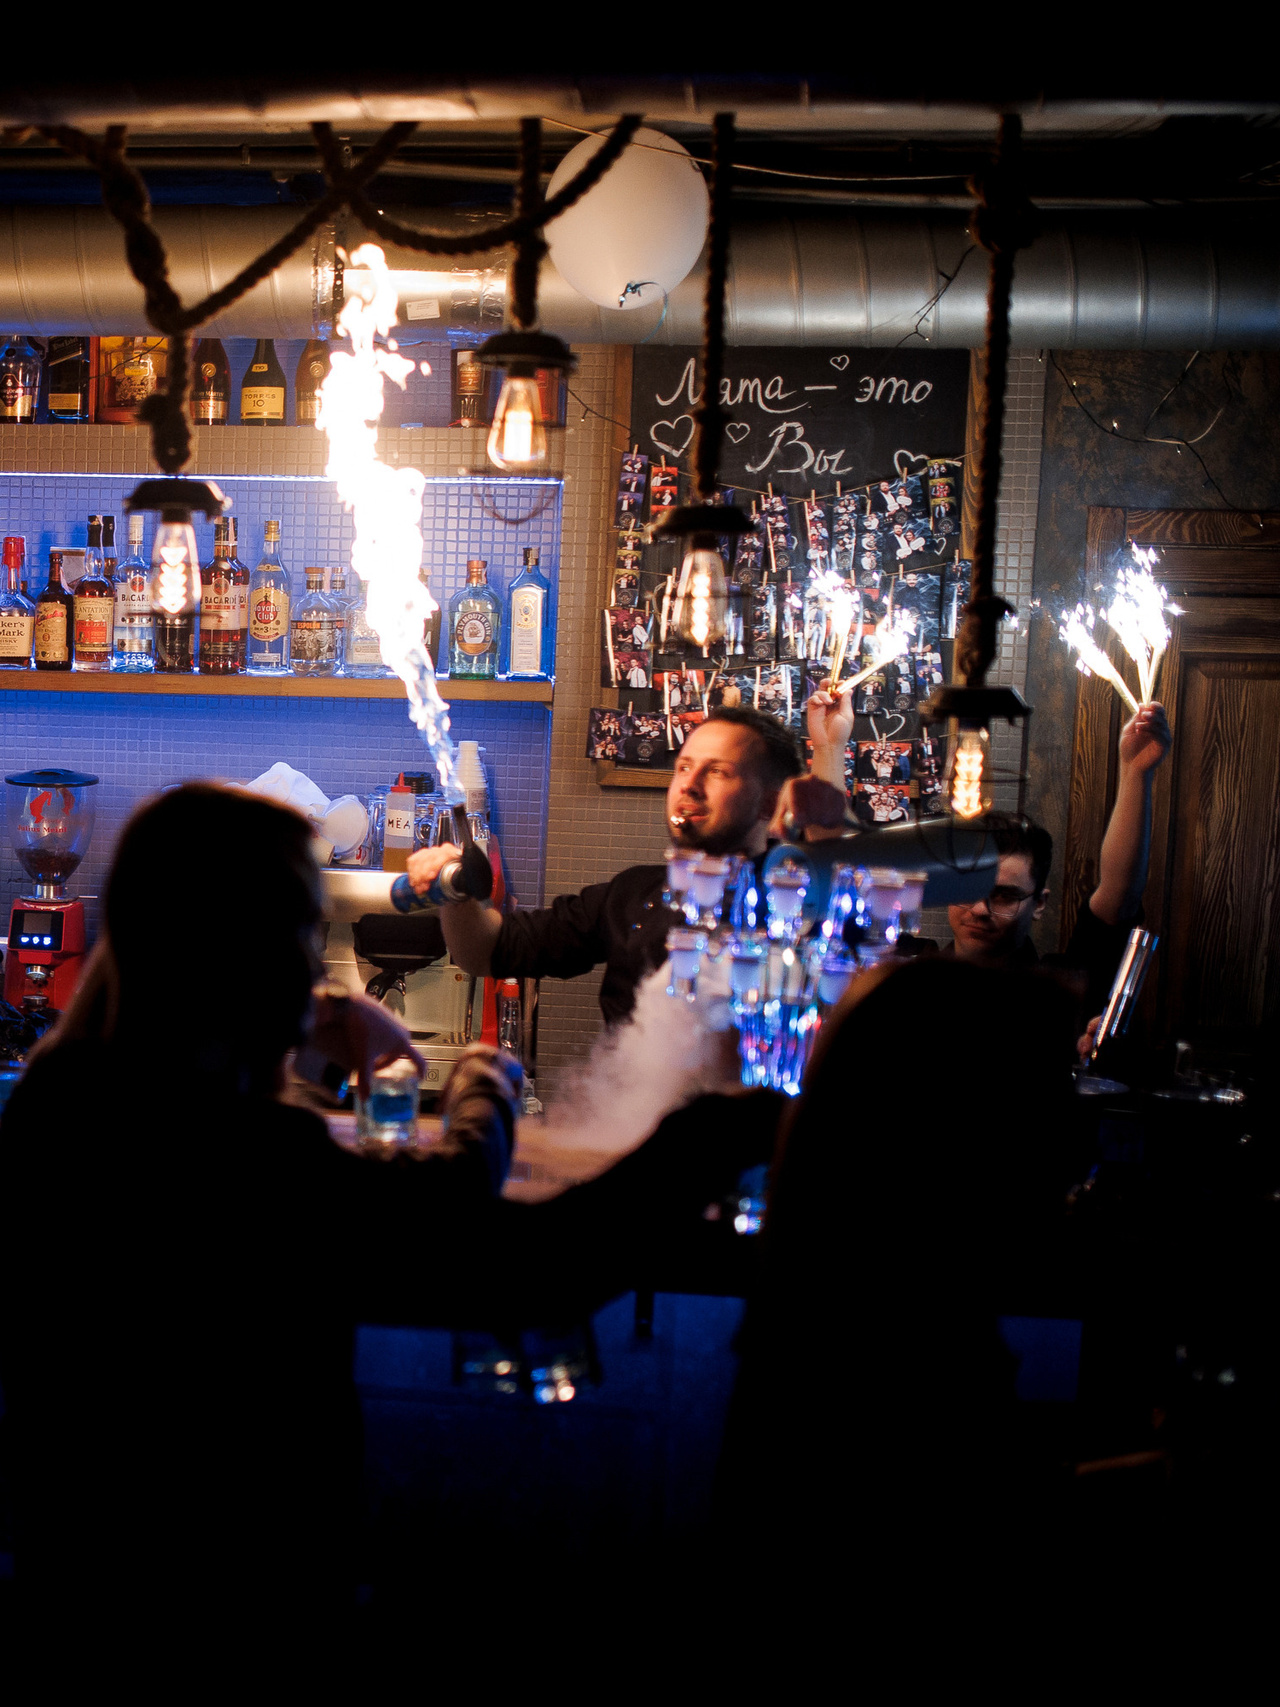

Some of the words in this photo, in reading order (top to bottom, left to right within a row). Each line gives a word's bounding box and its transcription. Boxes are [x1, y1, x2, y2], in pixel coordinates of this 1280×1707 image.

[854, 375, 934, 404] это
[252, 399, 265, 407] 10
[745, 422, 853, 475] Вы
[257, 612, 274, 620] Club
[457, 613, 486, 634] PLYMOUTH
[17, 824, 40, 833] Julius
